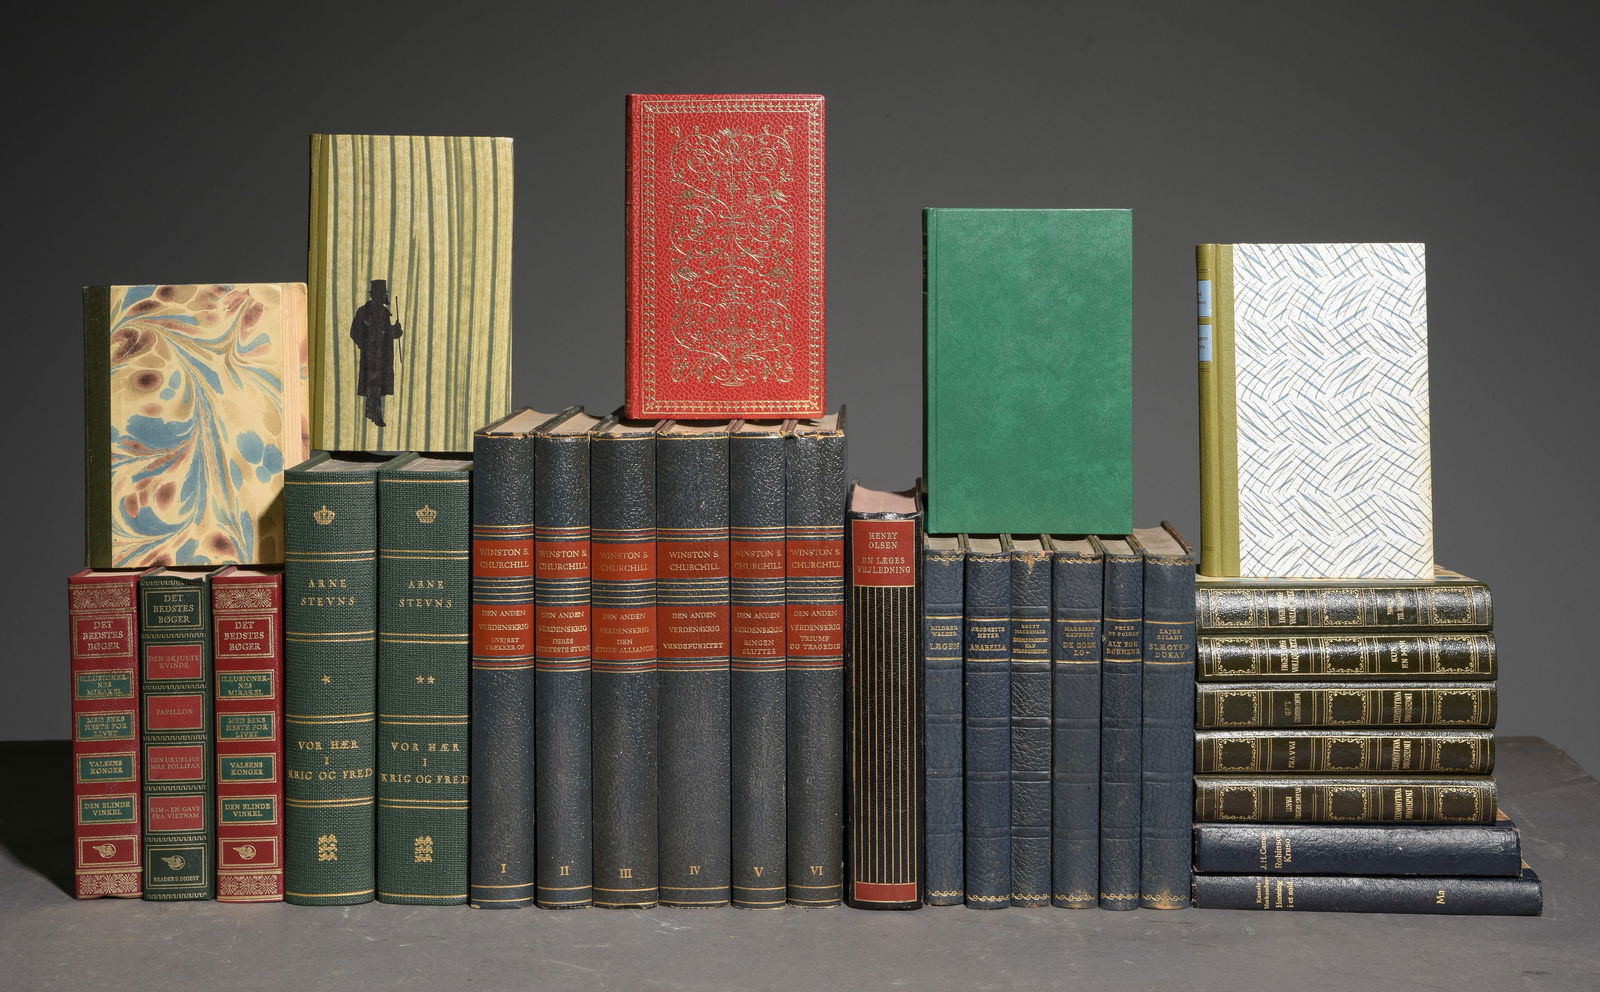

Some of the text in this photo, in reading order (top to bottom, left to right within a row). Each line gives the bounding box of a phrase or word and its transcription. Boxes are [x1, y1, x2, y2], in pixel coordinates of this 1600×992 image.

[868, 532, 898, 540] HENRY
[868, 541, 898, 549] OLSEN
[538, 550, 579, 558] WINSTON
[668, 551, 710, 559] WINSTON
[735, 550, 774, 558] WINSTON
[790, 549, 832, 557] WINSTON
[479, 561, 529, 569] CHURCHILL
[538, 563, 587, 571] CHURCHILL
[600, 564, 648, 572] CHURCHILL
[669, 563, 720, 571] CHURCHILL
[734, 562, 783, 570] CHURCHILL
[791, 561, 841, 569] CHURCHILL
[857, 566, 911, 574] VEJLEDNING
[308, 580, 347, 588] ARNE
[408, 581, 445, 589] ARNE
[164, 595, 183, 603] DET
[300, 597, 356, 606] STEVNS
[399, 599, 452, 608] STEVNS
[153, 605, 194, 613] BEDSTES
[158, 615, 190, 624] BØGER
[93, 621, 113, 629] DET
[234, 622, 255, 630] DET
[478, 623, 529, 631] VERDENSKRIG
[538, 625, 587, 633] VERDENSKRIG
[600, 627, 650, 635] VERDENSKRIG
[734, 626, 783, 634] VERDENSKRIG
[83, 632, 124, 640] BEDSTES
[224, 632, 265, 640] BEDSTES
[88, 643, 120, 651] BØGER
[229, 643, 261, 651] BØGER
[969, 643, 1007, 651] ARABELLA
[1390, 646, 1398, 663] KUN
[1402, 658, 1408, 669] EN
[156, 708, 193, 716] PAPILLON
[298, 740, 359, 750] VOR HÆR
[391, 742, 460, 752] VOR HÆR
[324, 757, 330, 765] I
[288, 768, 373, 780] KRIG OG FRED
[380, 774, 469, 784] KRIG OG FRED
[1274, 831, 1283, 869] Robinson
[1284, 838, 1292, 863] Kruso
[501, 863, 507, 874] I
[559, 865, 570, 876] II
[689, 865, 701, 875] IV
[753, 866, 764, 878] V
[810, 865, 824, 876] VI
[619, 868, 633, 879] III
[1276, 880, 1284, 908] Honning
[1436, 890, 1446, 905] Ma
